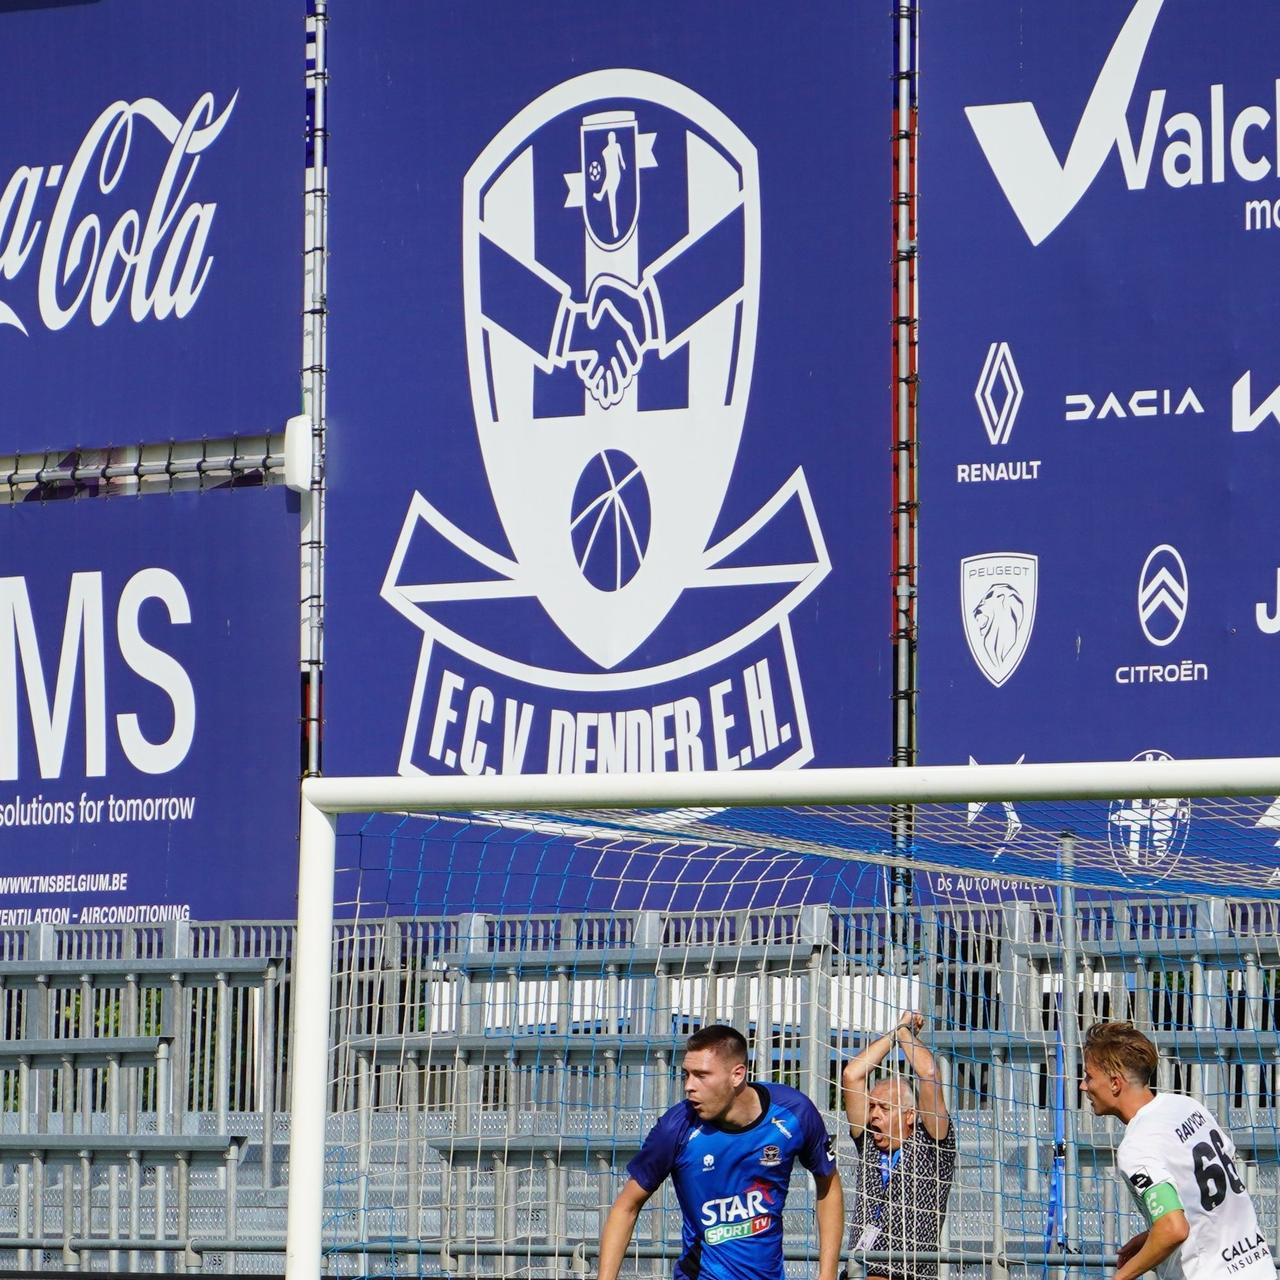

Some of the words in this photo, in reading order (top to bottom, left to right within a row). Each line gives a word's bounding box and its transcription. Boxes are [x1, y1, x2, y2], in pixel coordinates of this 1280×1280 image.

[1066, 387, 1204, 420] DACIA
[958, 461, 1041, 482] RENAULT
[969, 566, 1030, 579] PEUGEOT
[428, 669, 535, 776] F.C.V
[709, 657, 792, 771] E.H.
[79, 793, 104, 823] for
[108, 795, 195, 822] tomorrow
[0, 873, 127, 894] WWW.TMSBELGIUM.BE
[80, 905, 190, 924] AIRCONDITIONING
[1192, 1128, 1246, 1212] 66
[701, 1190, 768, 1226] STAR
[707, 1224, 751, 1244] SPORT
[754, 1216, 770, 1229] TV
